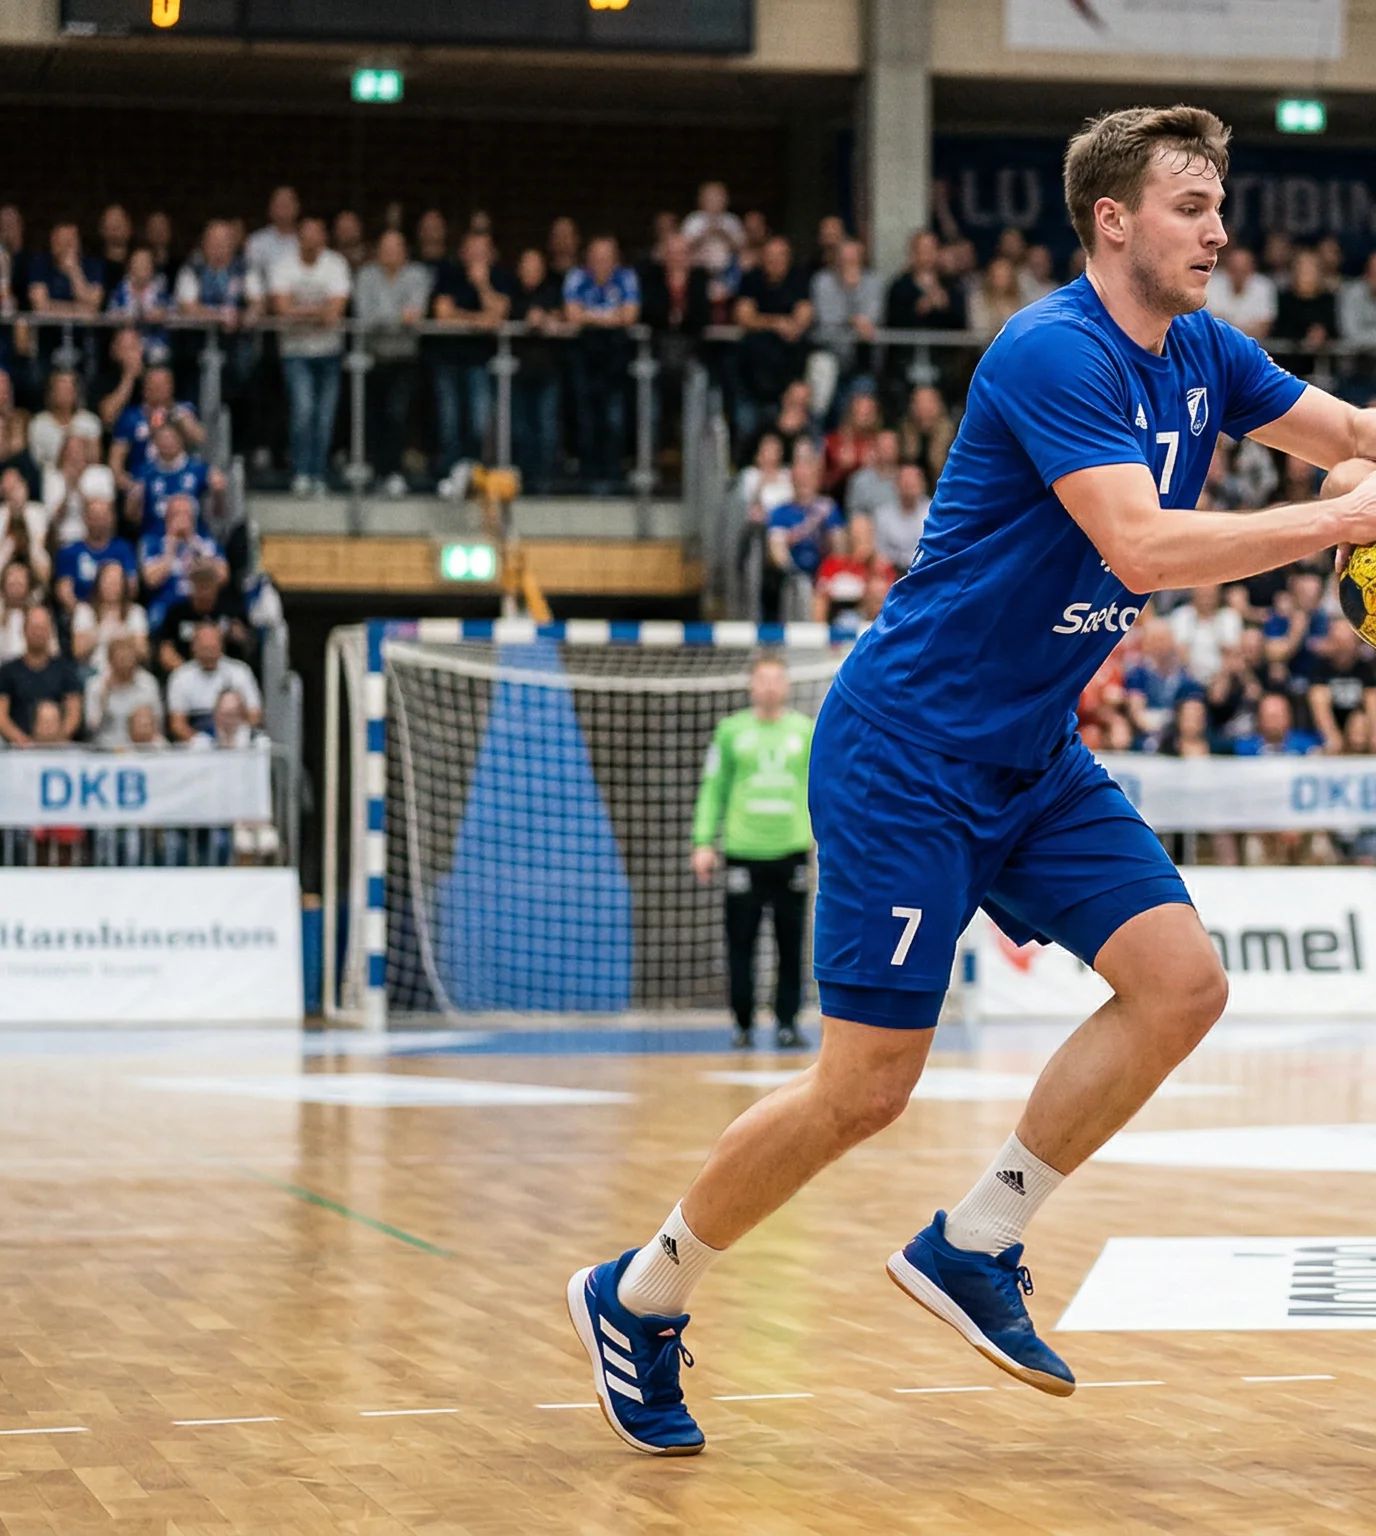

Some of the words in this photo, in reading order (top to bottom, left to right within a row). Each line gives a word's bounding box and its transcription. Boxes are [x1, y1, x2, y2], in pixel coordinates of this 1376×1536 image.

[1156, 431, 1179, 494] 7
[40, 768, 148, 811] DKB
[890, 906, 923, 966] 7
